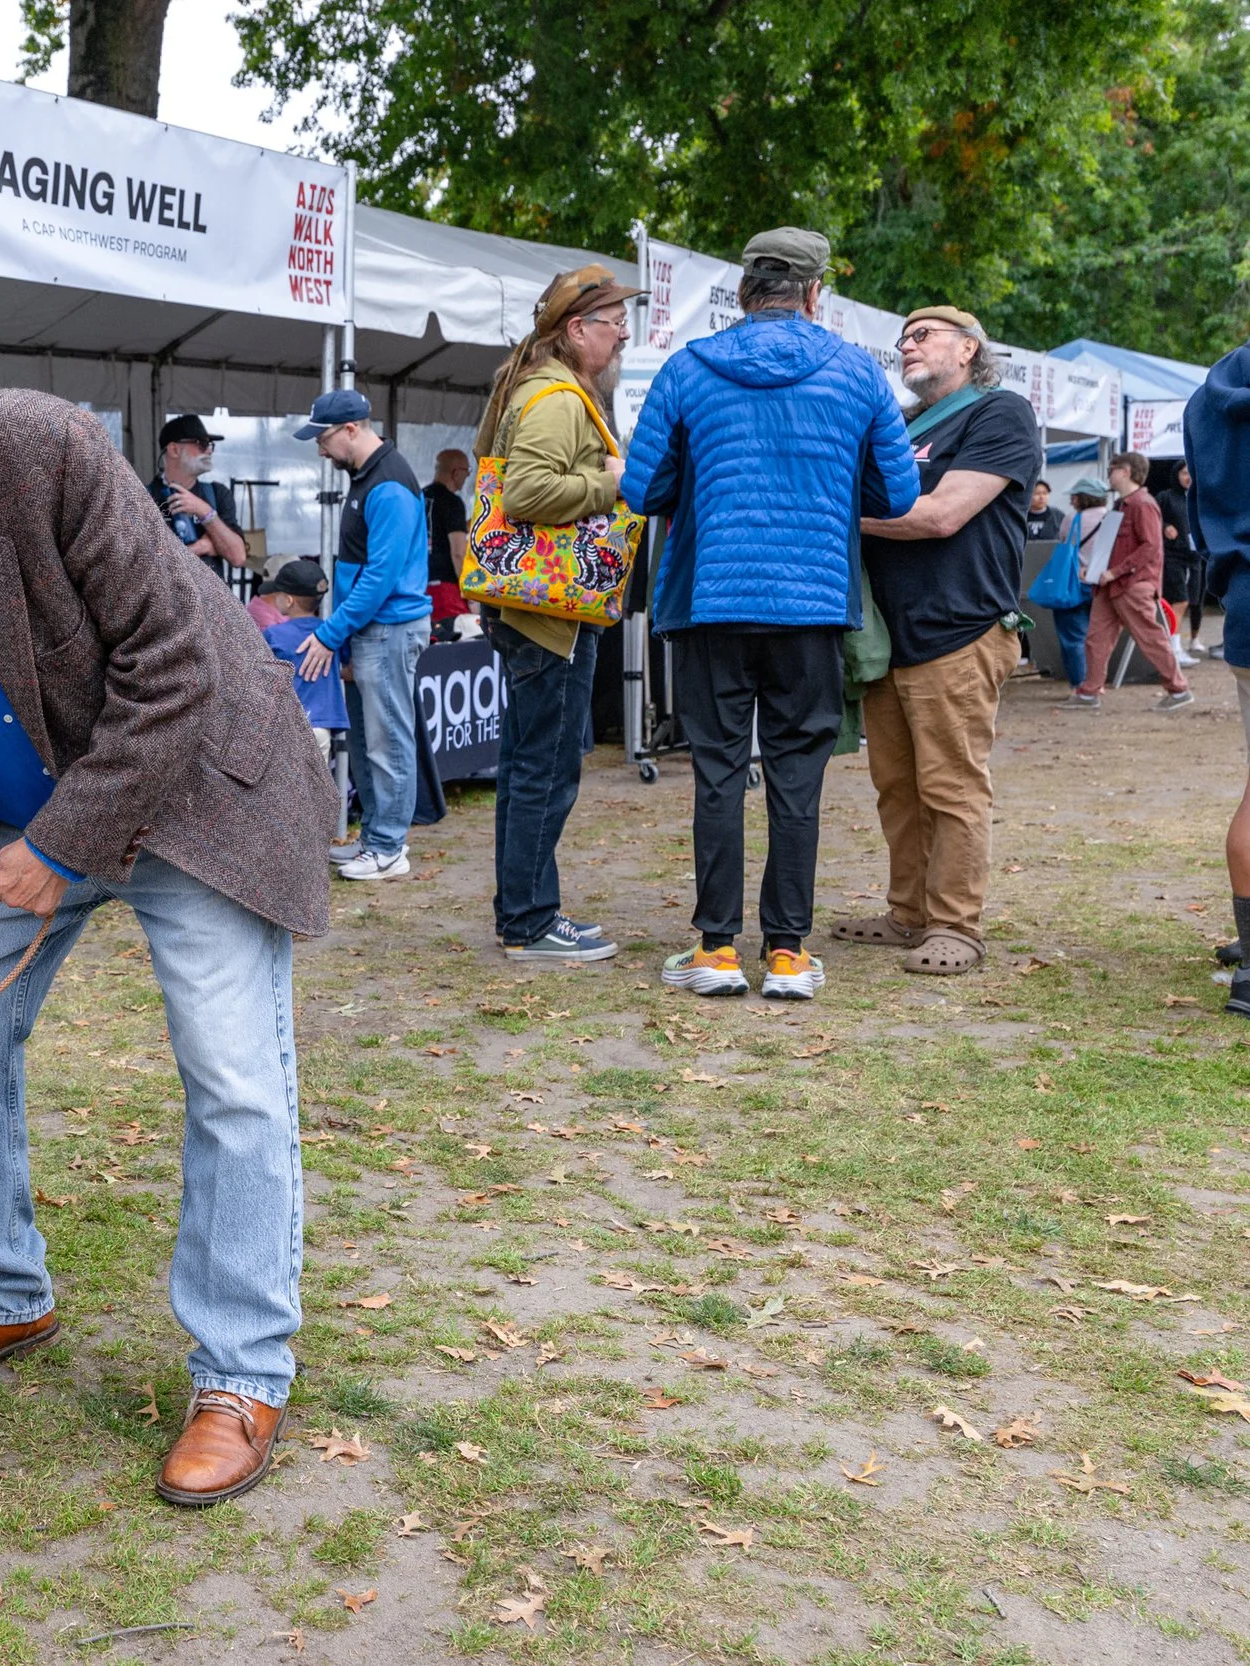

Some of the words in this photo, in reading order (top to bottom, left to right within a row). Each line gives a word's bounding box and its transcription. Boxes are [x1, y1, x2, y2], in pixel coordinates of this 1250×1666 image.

[127, 176, 208, 234] WELL
[296, 181, 336, 216] AIDS
[22, 218, 31, 233] A
[33, 220, 56, 237] CAP
[59, 226, 130, 253] NORTHWEST
[133, 240, 188, 263] PROGRAM
[292, 213, 334, 248] WALK
[288, 245, 335, 275] NORTH
[288, 274, 333, 307] WEST
[446, 724, 472, 751] FOR
[476, 716, 500, 743] THE
